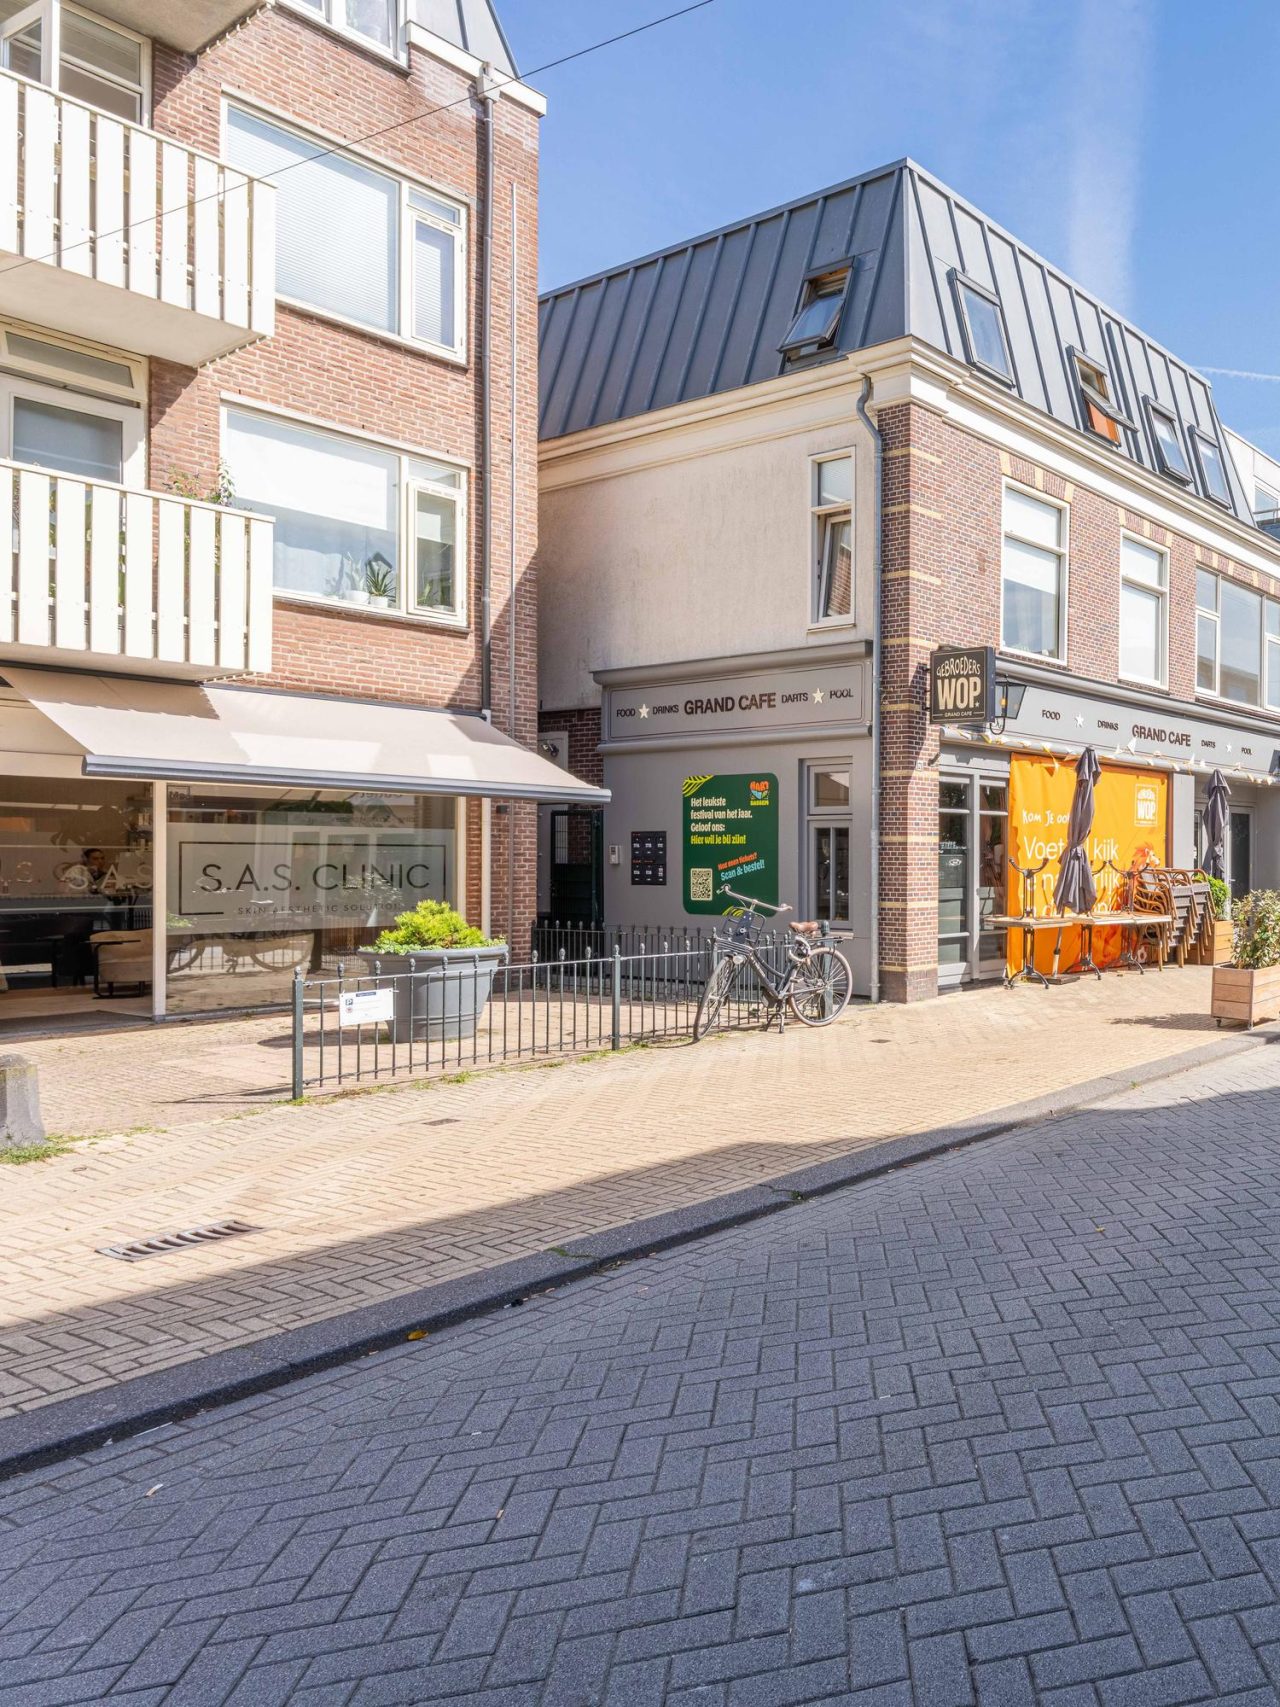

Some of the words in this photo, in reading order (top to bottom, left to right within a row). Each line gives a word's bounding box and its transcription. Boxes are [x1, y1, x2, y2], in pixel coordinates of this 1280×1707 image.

[936, 656, 981, 677] GEBROEDERS
[616, 708, 636, 718] FOOD
[652, 704, 680, 715] DRINKS
[684, 697, 735, 715] GRAND
[738, 692, 777, 711] CAFE
[781, 692, 809, 704] DARTS
[829, 688, 854, 700] POOL
[937, 677, 982, 710] WOP
[1041, 709, 1061, 721] FOOD
[1097, 719, 1119, 731] DRINKS
[1131, 724, 1167, 743] GRAND
[1168, 730, 1192, 747] CAFE
[1201, 739, 1216, 748] DARTS
[1241, 747, 1253, 756] POOL
[690, 798, 702, 807] Het
[702, 797, 726, 807] leukste
[690, 809, 714, 820] festival
[714, 811, 726, 819] van
[727, 809, 738, 819] het
[690, 822, 711, 832] Geloof
[711, 823, 726, 832] ons:
[690, 835, 704, 845] Hier
[704, 835, 715, 844] wil
[715, 835, 722, 844] je
[722, 834, 731, 844] bij
[732, 834, 746, 844] zijn!
[1093, 838, 1119, 860] kijk
[200, 863, 301, 892] S.A.S.
[312, 863, 430, 891] CLINIC
[720, 869, 736, 882] Scan
[736, 866, 744, 875] &
[743, 859, 766, 874] bestel!
[237, 907, 267, 916] SKIN
